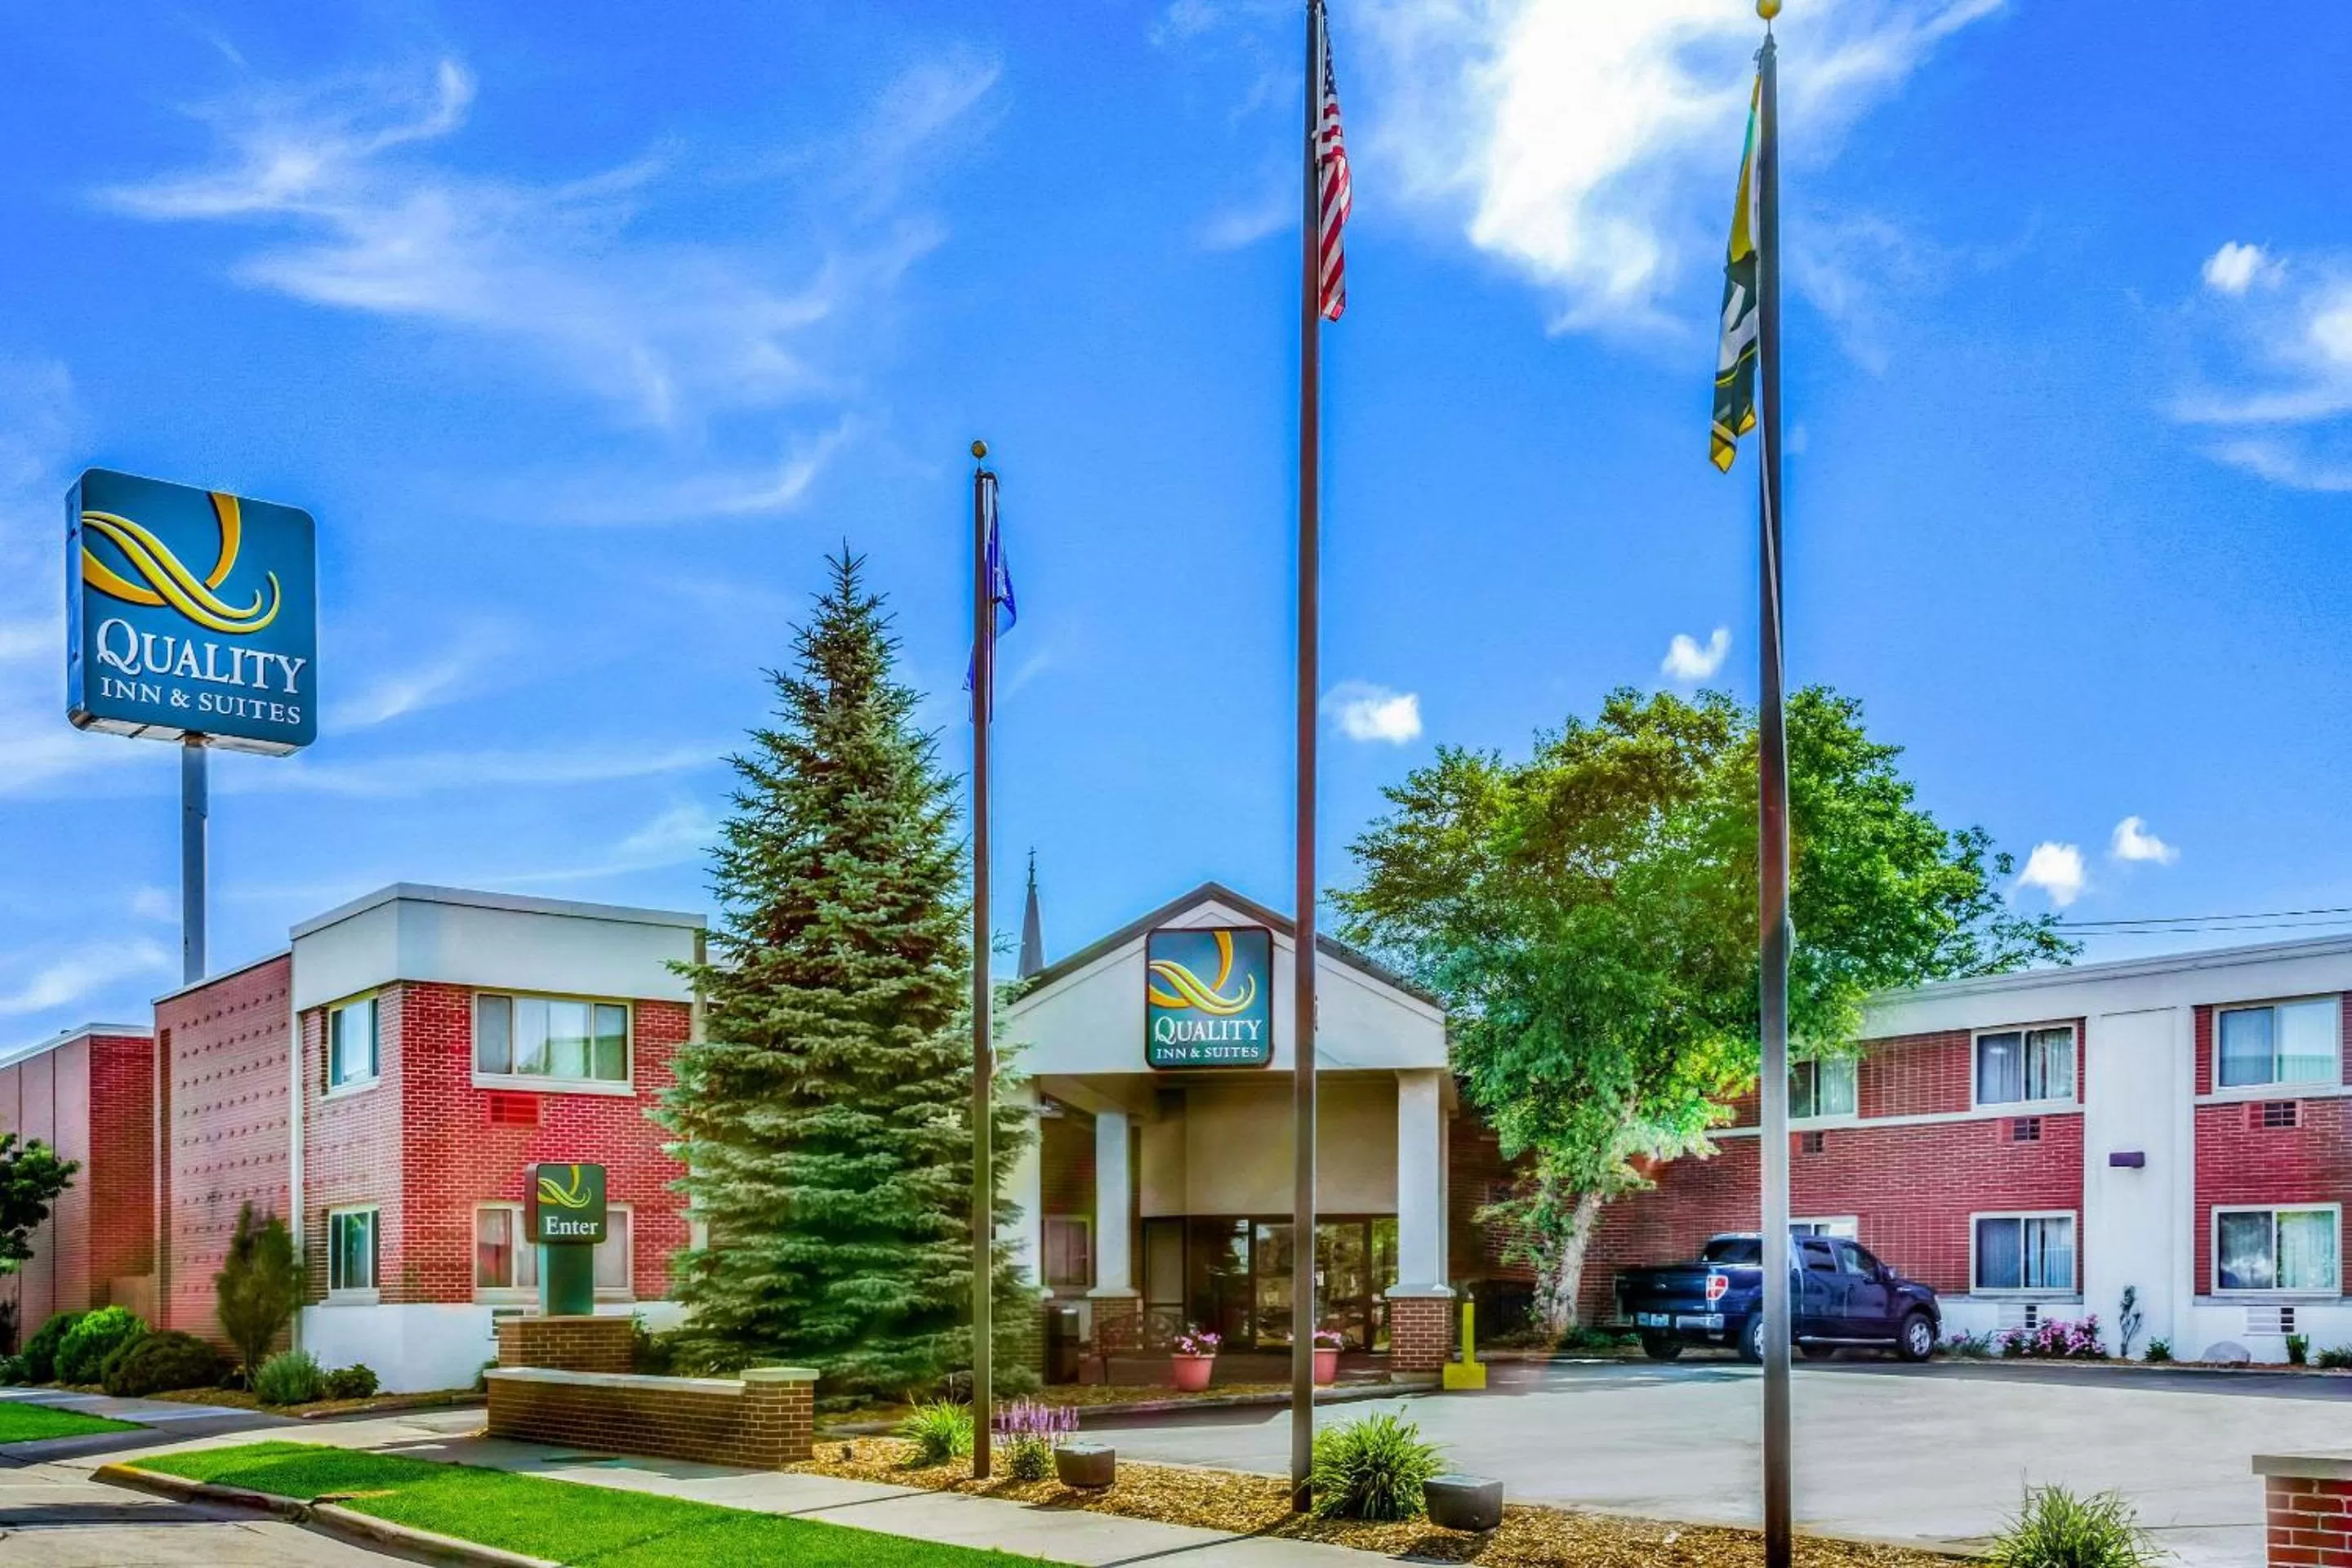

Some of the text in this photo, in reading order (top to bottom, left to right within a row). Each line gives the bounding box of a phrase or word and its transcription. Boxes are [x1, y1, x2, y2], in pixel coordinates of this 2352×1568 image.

[96, 618, 306, 695] QUALITY
[101, 677, 301, 725] INN & SUITES
[1155, 1015, 1263, 1045] QUALITY
[1156, 1047, 1258, 1058] INN & SUITES
[545, 1216, 599, 1235] Enter
